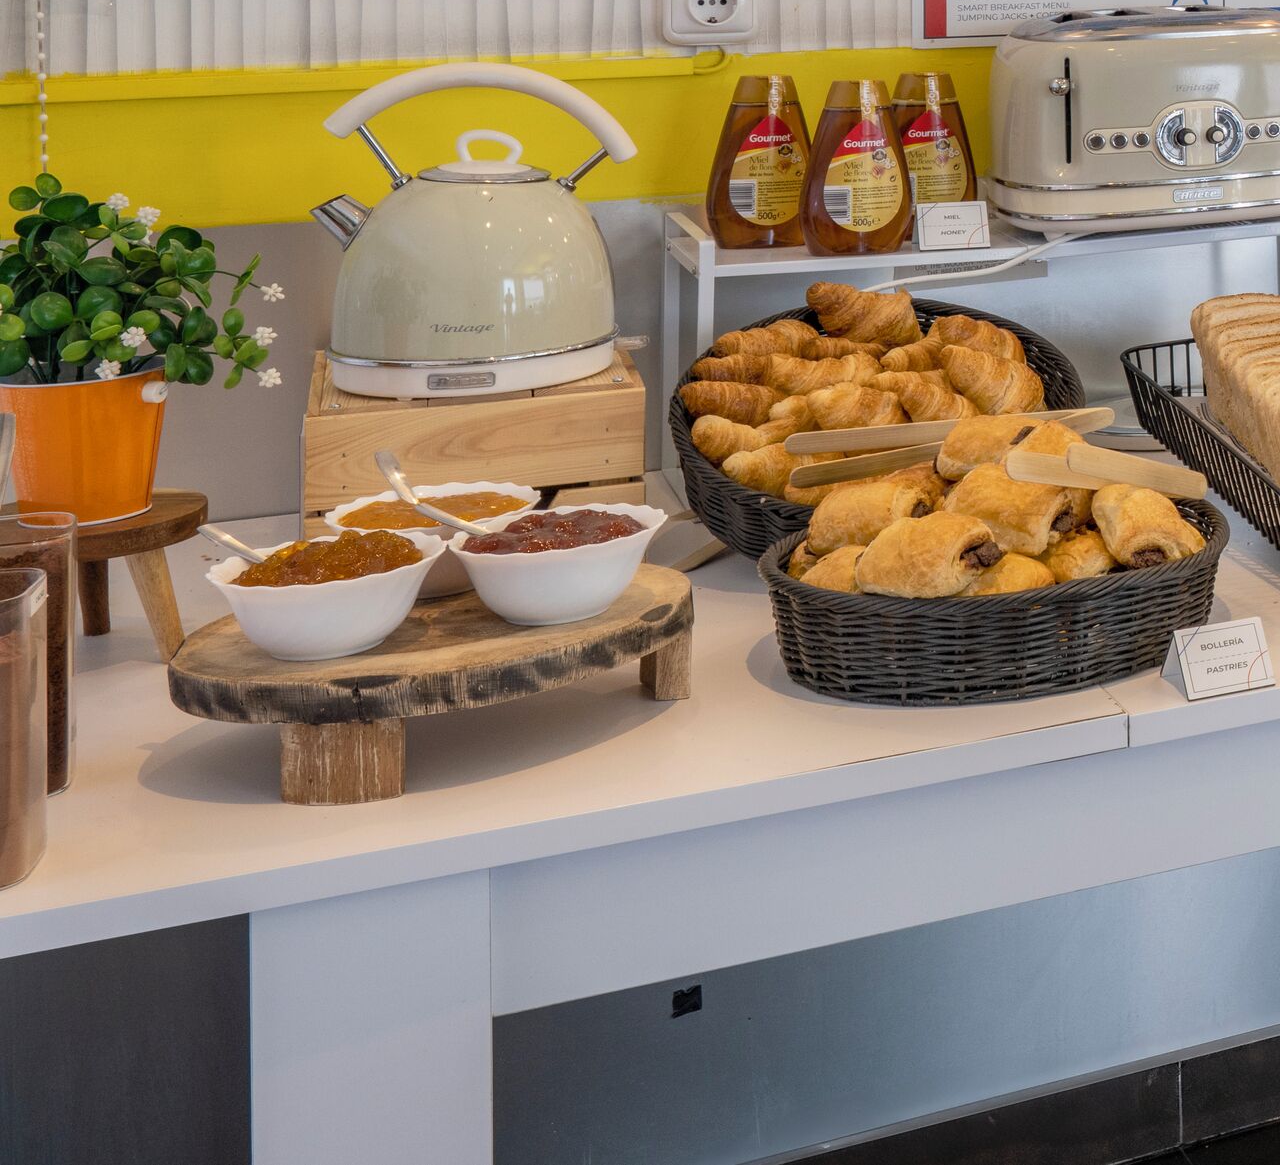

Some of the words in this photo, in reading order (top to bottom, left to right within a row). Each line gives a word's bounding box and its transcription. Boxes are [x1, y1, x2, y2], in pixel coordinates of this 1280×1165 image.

[957, 3, 988, 12] SMART
[990, 3, 1041, 11] BREAKFAST
[1042, 2, 1071, 10] MENU:
[957, 13, 999, 22] JUMPING
[1000, 13, 1028, 21] JACKS
[750, 133, 791, 143] Gourmet
[908, 129, 948, 138] Gourmet
[844, 138, 886, 148] Gourmet
[908, 150, 927, 158] Miel
[750, 156, 769, 164] Miel
[844, 161, 864, 170] Miel
[1180, 190, 1217, 200] Ariete
[758, 212, 777, 220] 500g
[853, 218, 872, 227] 500g
[430, 324, 495, 333] Vintage
[1200, 637, 1244, 651] BOLLERÍA
[1206, 661, 1248, 675] PASTRIES
